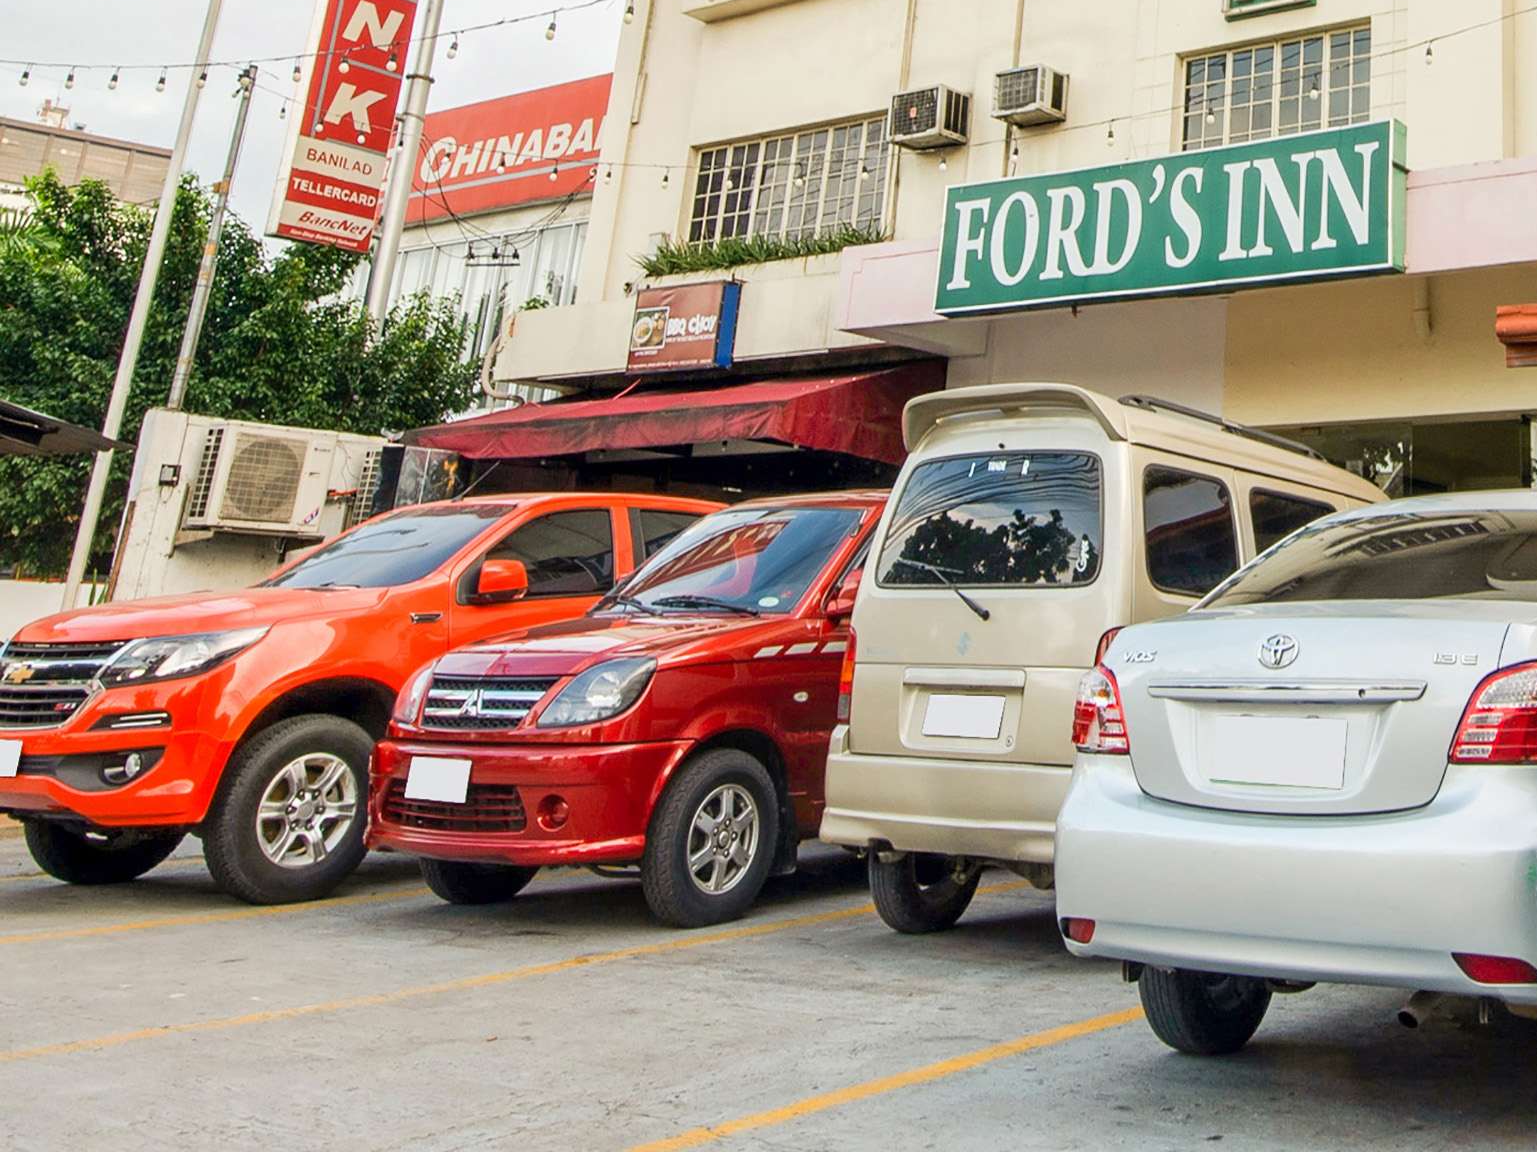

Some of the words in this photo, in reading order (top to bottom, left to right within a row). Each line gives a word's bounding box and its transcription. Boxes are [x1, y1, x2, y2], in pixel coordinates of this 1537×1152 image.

[306, 148, 372, 176] BANILAD
[420, 115, 607, 183] CHINABA
[292, 177, 376, 208] TELLERCARD
[298, 210, 368, 236] BancNet
[946, 163, 1204, 291] FORD'S
[1218, 141, 1380, 262] INN
[667, 317, 687, 336] BBQ
[1124, 650, 1158, 664] VIOS
